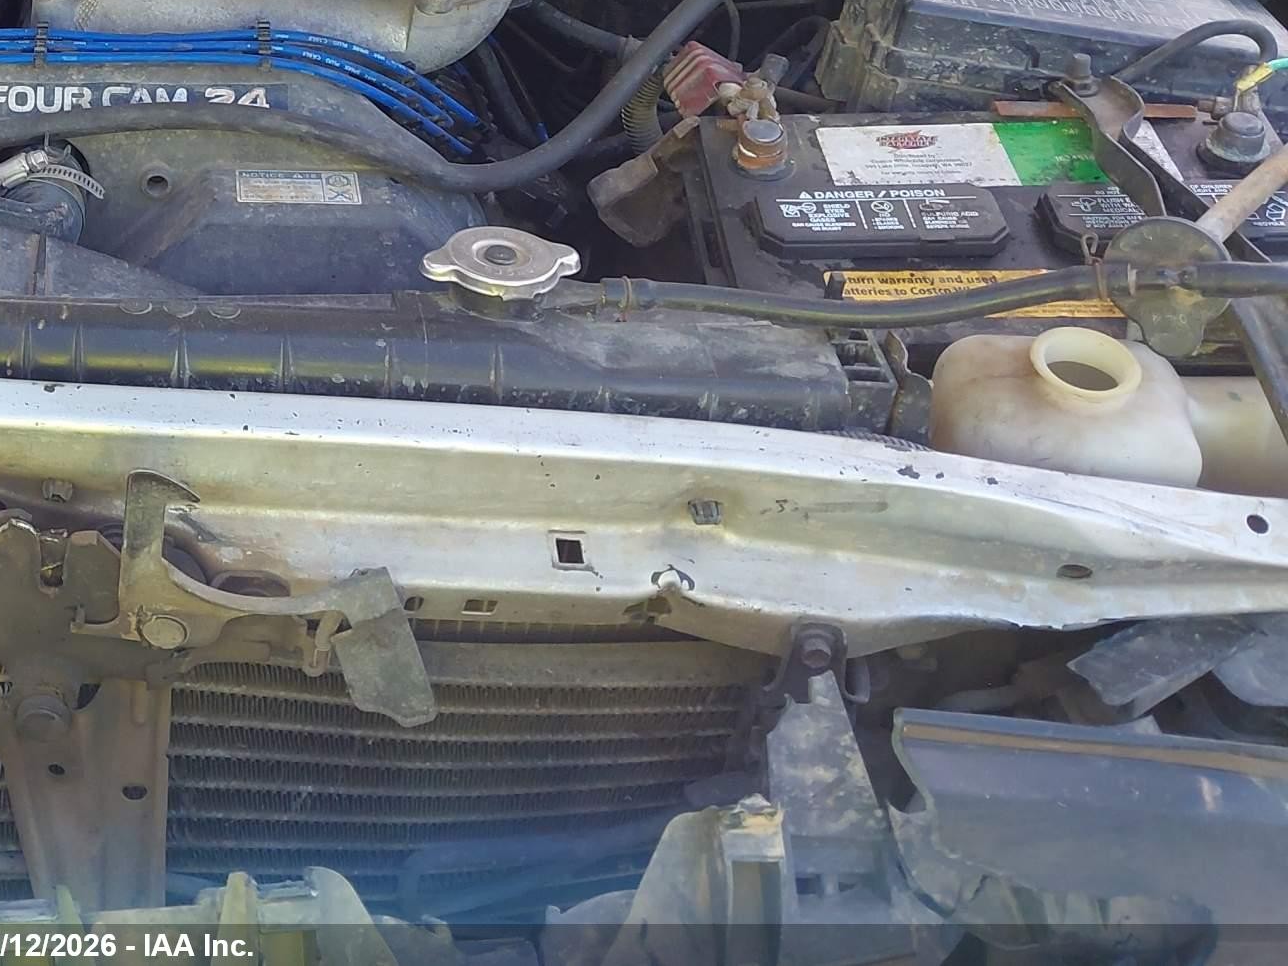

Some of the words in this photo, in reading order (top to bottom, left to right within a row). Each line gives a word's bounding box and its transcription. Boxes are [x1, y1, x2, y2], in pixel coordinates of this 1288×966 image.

[813, 190, 875, 199] DANGER
[888, 189, 946, 197] POISON
[847, 276, 875, 284] turn
[877, 275, 935, 285] warranty
[938, 275, 963, 284] and
[966, 275, 998, 284] used
[844, 287, 890, 296] atteries
[894, 288, 907, 296] to
